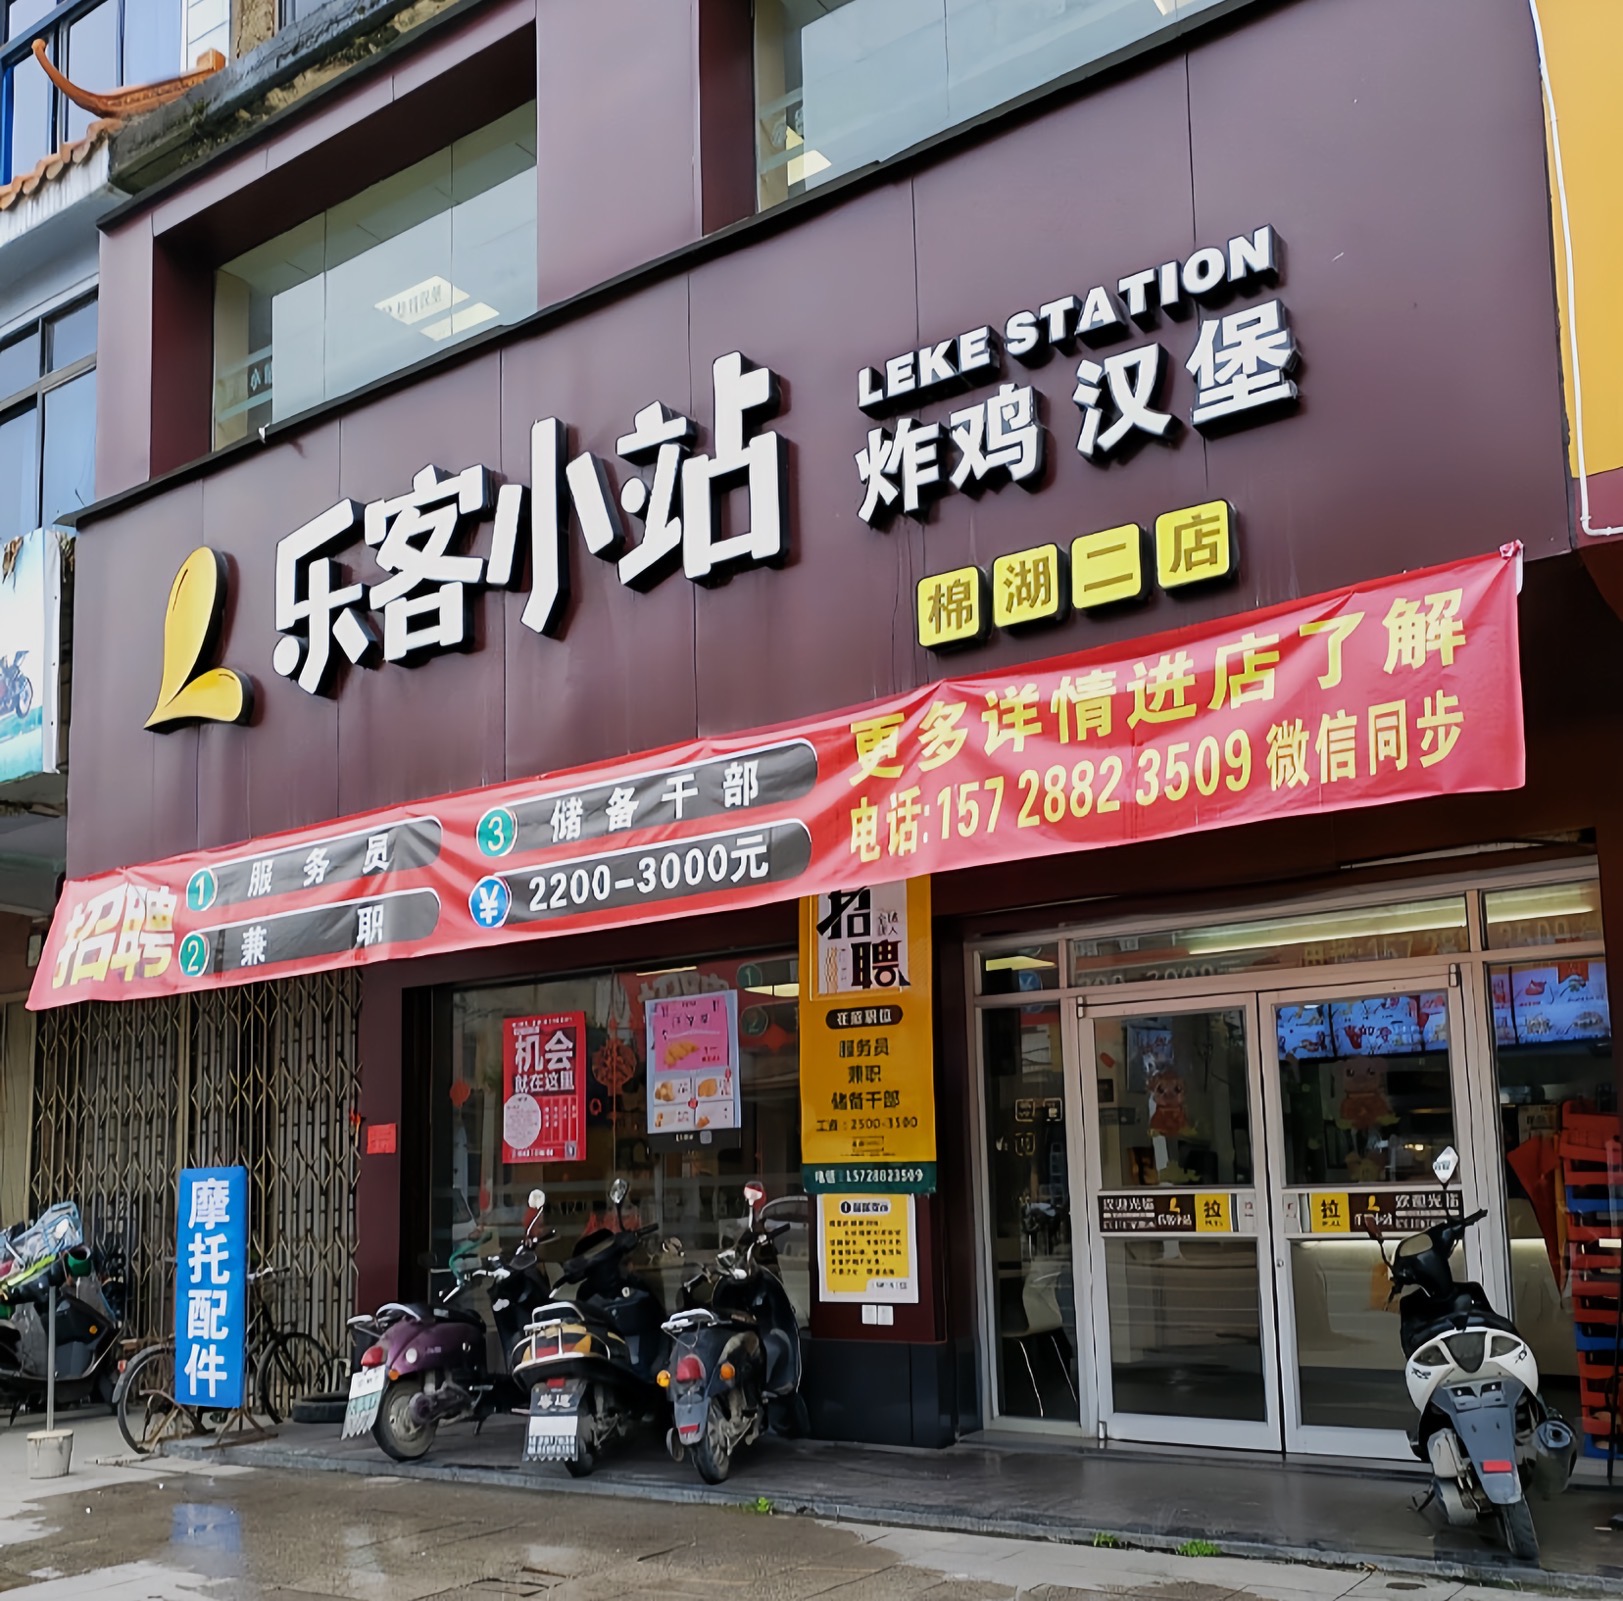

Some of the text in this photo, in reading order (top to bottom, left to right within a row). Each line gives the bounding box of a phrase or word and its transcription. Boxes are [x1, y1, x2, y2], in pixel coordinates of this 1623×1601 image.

[858, 225, 1273, 408] LEKE STATION
[854, 299, 1297, 522] 炸鸡 汉堡
[271, 350, 782, 695] 乐客小站
[927, 514, 1221, 635] 棉湖二店
[849, 588, 1466, 786] 更多详情进店了解
[550, 760, 759, 842] 储备干部
[247, 833, 390, 898] 服务员
[528, 834, 769, 912] 2200-3000元
[52, 882, 178, 990] 招聘
[240, 903, 385, 968] 兼职
[514, 1070, 575, 1094] 就在这里
[515, 1030, 574, 1074] 机会
[1204, 1199, 1222, 1218] 拉
[1320, 1199, 1341, 1219] 拉
[183, 1177, 231, 1398] 摩托配件
